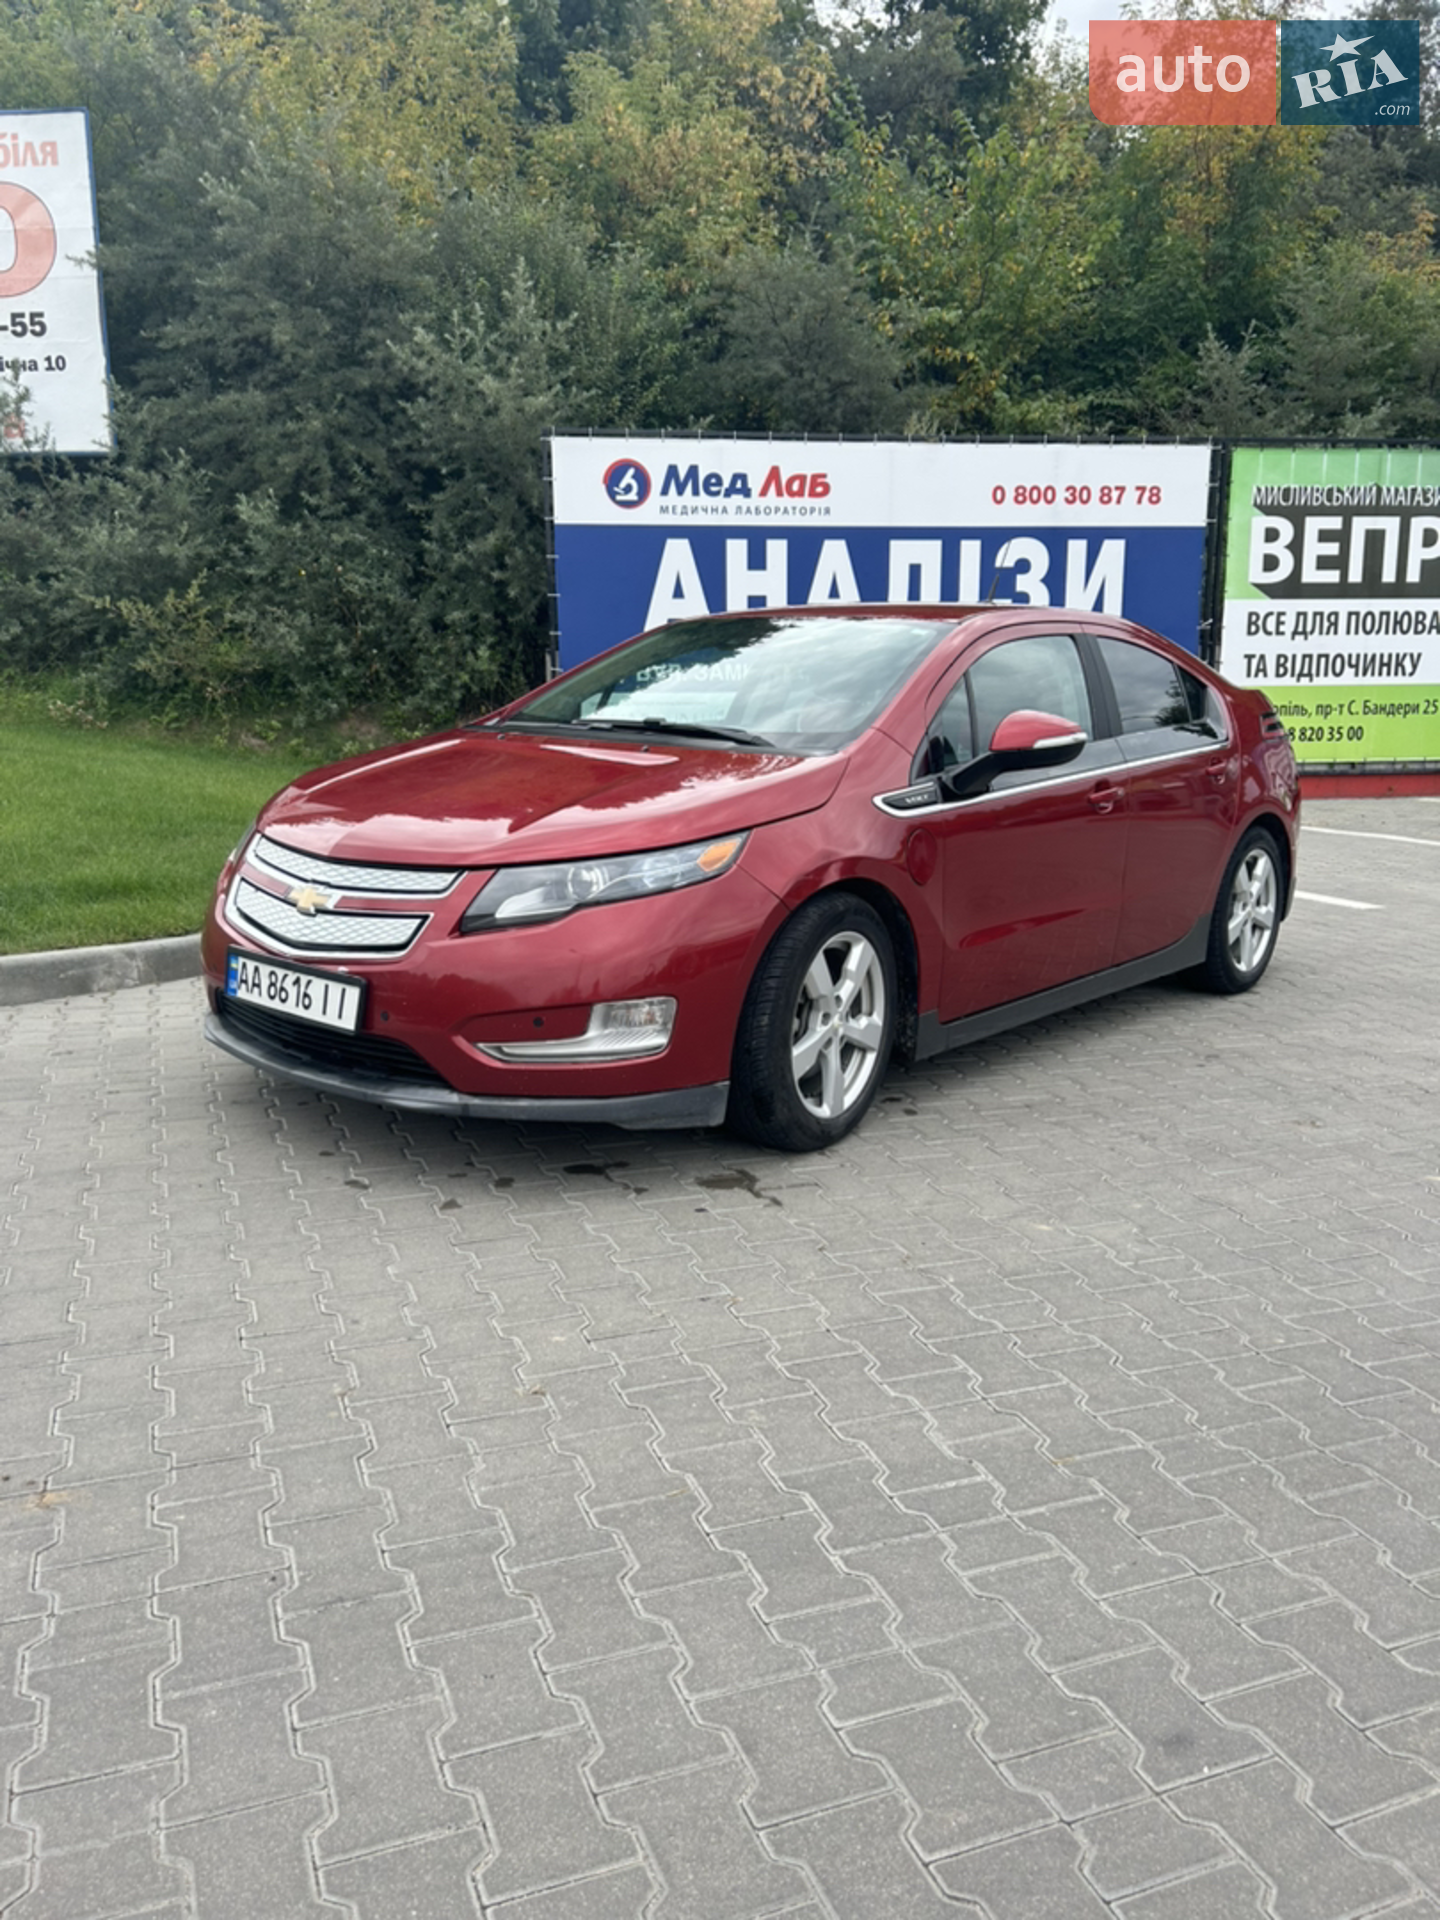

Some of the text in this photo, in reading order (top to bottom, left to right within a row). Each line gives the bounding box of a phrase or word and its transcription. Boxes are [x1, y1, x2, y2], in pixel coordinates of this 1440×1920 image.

[44, 354, 67, 372] 10
[659, 464, 831, 499] Мед Лаб
[991, 484, 1162, 505] 0 800 30 87 78
[1252, 482, 1377, 507] МИСЛИВСЬКИЙ
[659, 505, 832, 517] МЕДИЧНА ЛАБОРАТОРІЯ
[643, 536, 1126, 632] АНАЛІЗИ
[1246, 610, 1440, 641] ВСЕ ДЛЯ ПОЛЮВА
[1244, 652, 1422, 683] ТА ВІДПОЧИНКУ
[1315, 702, 1345, 719] пр-т
[1362, 700, 1420, 718] Бандери
[1422, 700, 1439, 715] 25
[1298, 726, 1325, 742] 820
[1326, 726, 1344, 741] 35
[1346, 726, 1365, 741] 00
[238, 961, 262, 997] AA
[267, 970, 313, 1011] 8616
